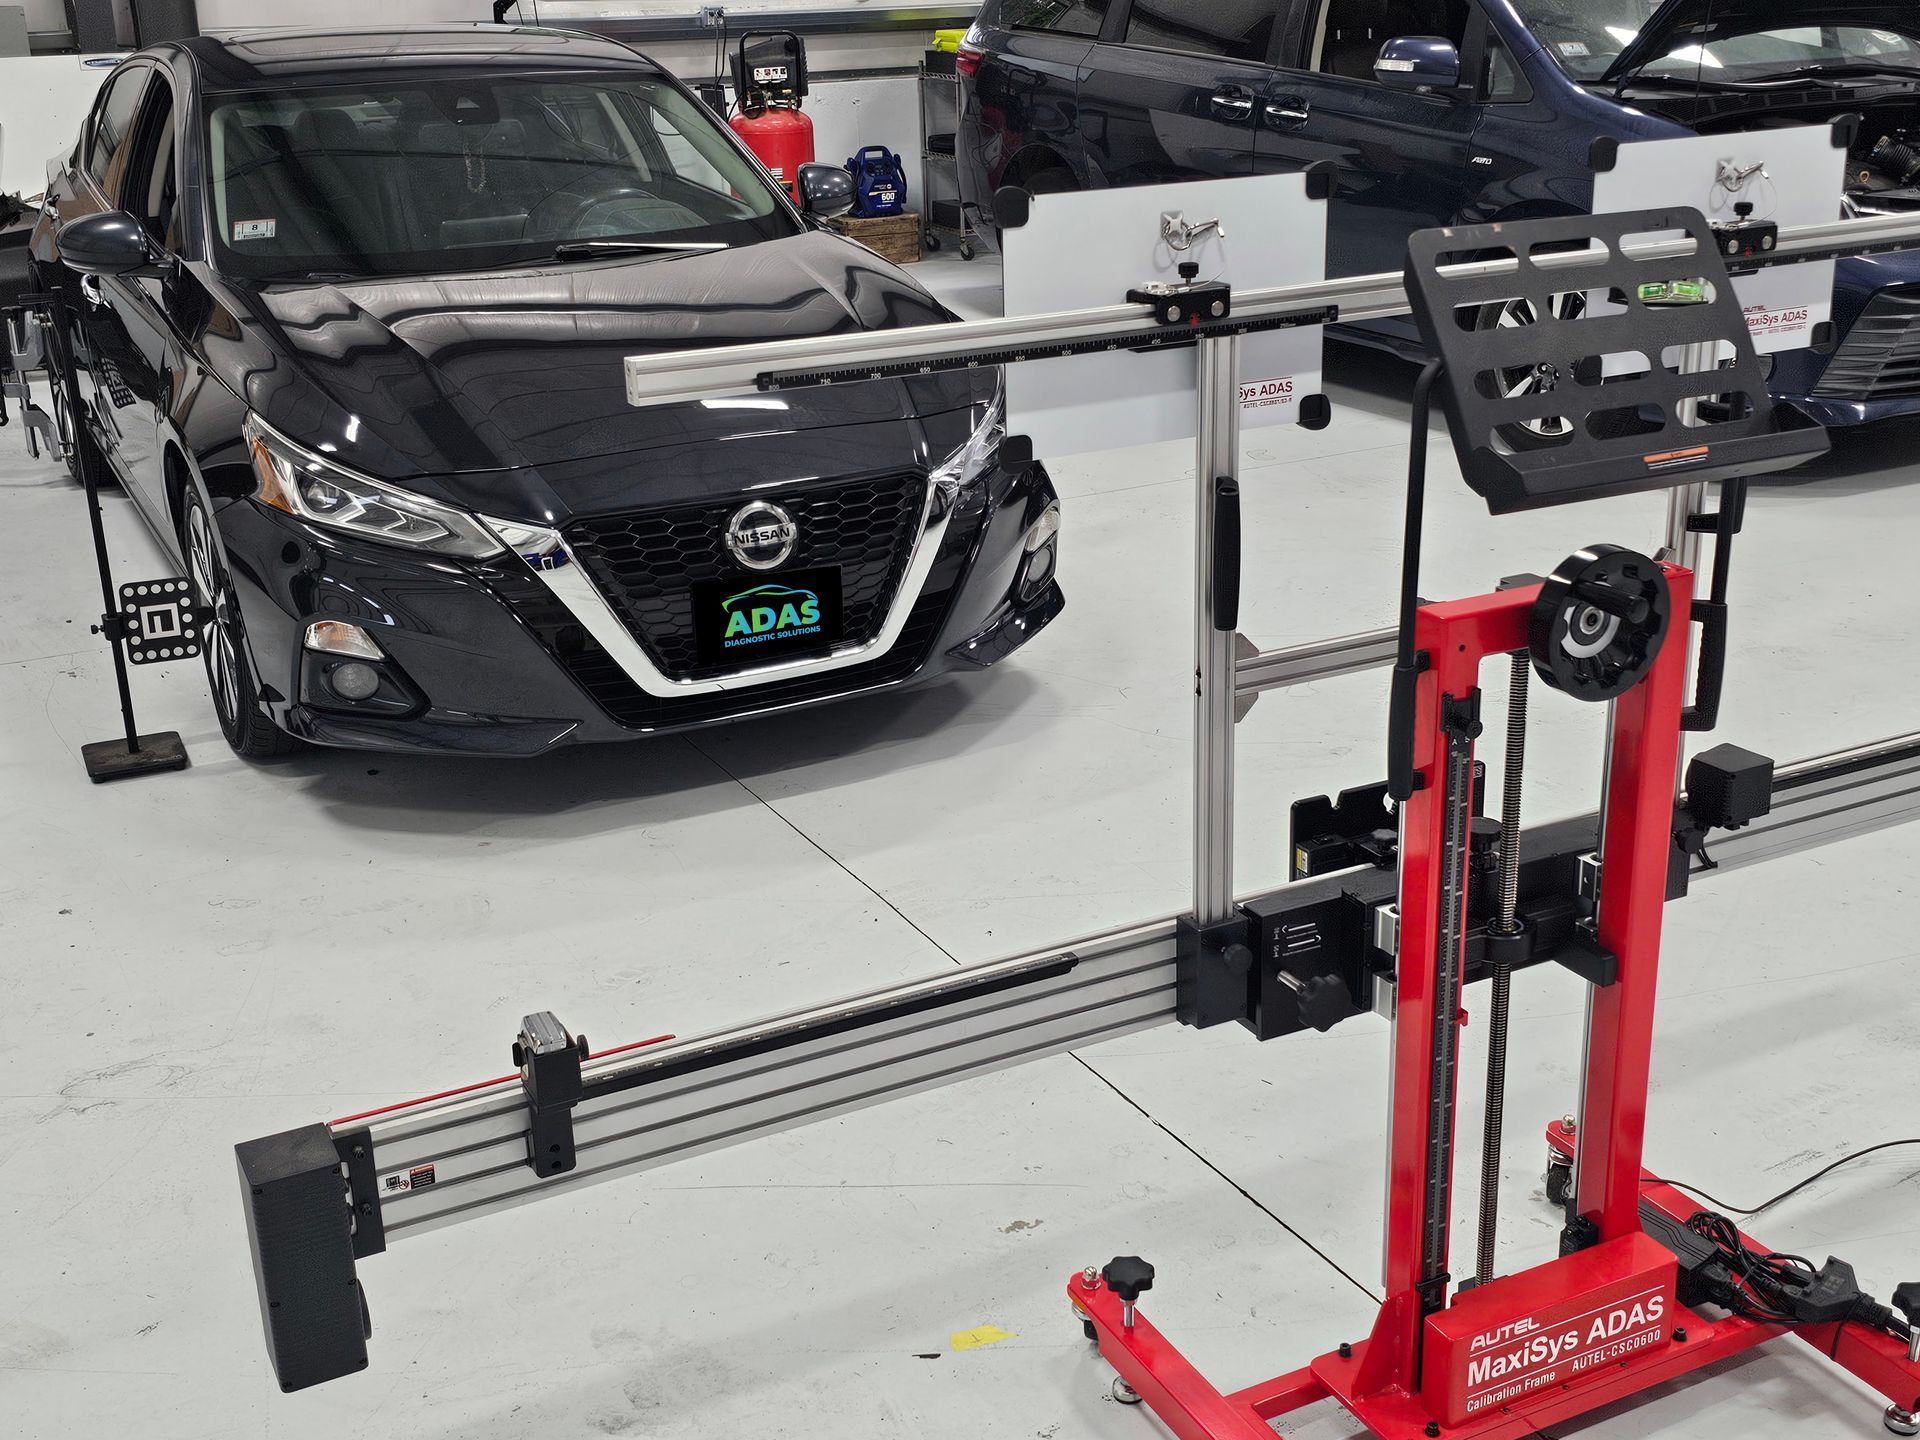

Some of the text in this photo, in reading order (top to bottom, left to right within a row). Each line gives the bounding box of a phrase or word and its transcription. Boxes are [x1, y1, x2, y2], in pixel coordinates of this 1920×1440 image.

[881, 192, 895, 201] 600
[1780, 309, 1808, 323] ADAS
[820, 378, 831, 386] 750
[871, 372, 881, 380] 700
[1259, 381, 1293, 396] ADAS
[734, 527, 790, 545] NISSAN
[1467, 1295, 1664, 1388] MaxiSys ADAS
[1470, 1317, 1541, 1352] AUTEL
[1466, 1329, 1661, 1412] Calibration Frame AUTEL-CSC0600
